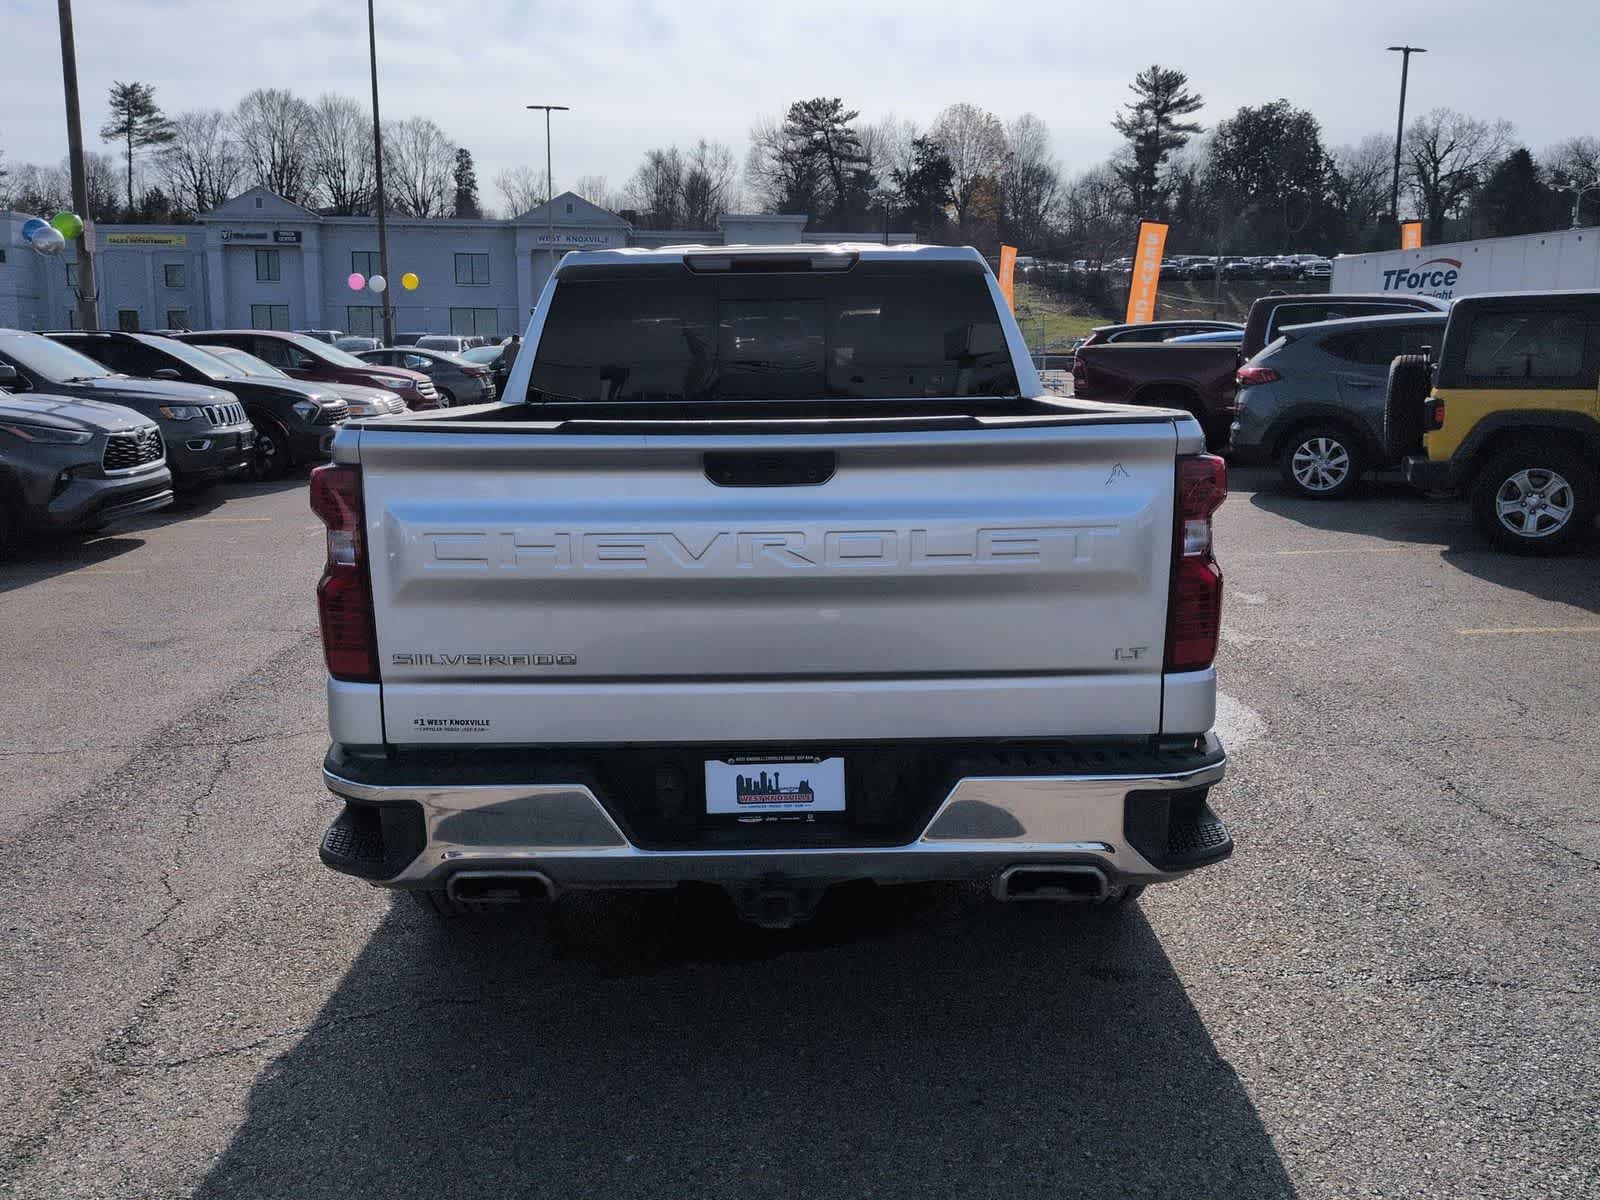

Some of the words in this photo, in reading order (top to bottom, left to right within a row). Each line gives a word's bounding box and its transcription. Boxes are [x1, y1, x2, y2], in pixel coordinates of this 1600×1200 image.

[1384, 268, 1457, 290] TForce
[1417, 289, 1453, 300] ight
[422, 524, 1121, 570] CHEVROLET
[392, 653, 577, 666] SILVERADO
[1113, 647, 1149, 661] LT
[413, 718, 425, 726] #1
